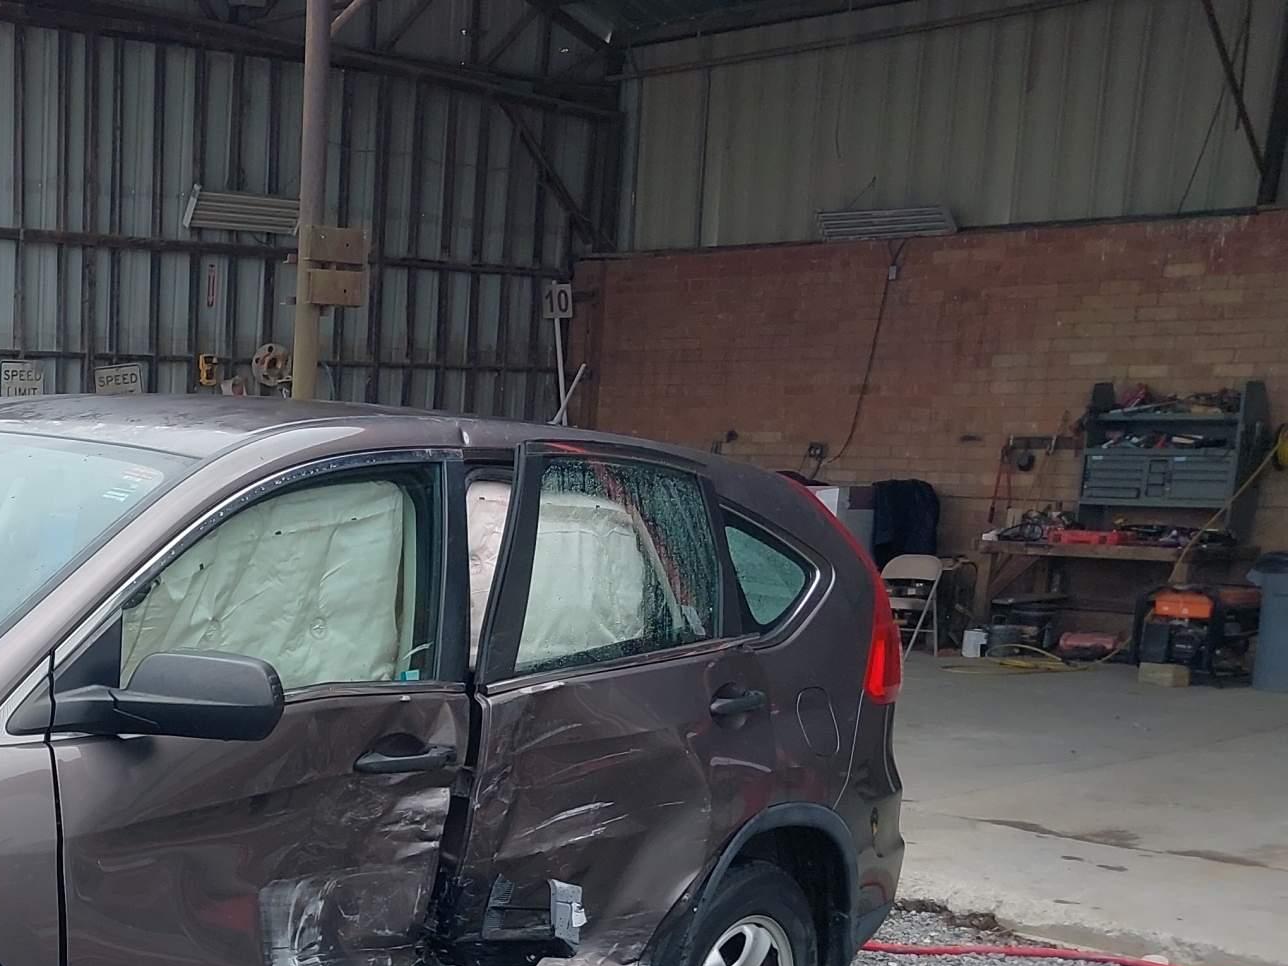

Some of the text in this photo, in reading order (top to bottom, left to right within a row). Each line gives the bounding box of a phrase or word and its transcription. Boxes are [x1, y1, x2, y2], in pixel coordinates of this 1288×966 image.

[545, 289, 569, 313] 10
[3, 369, 43, 382] SPEED
[97, 373, 138, 387] SPEED
[6, 387, 40, 397] LIMIT
